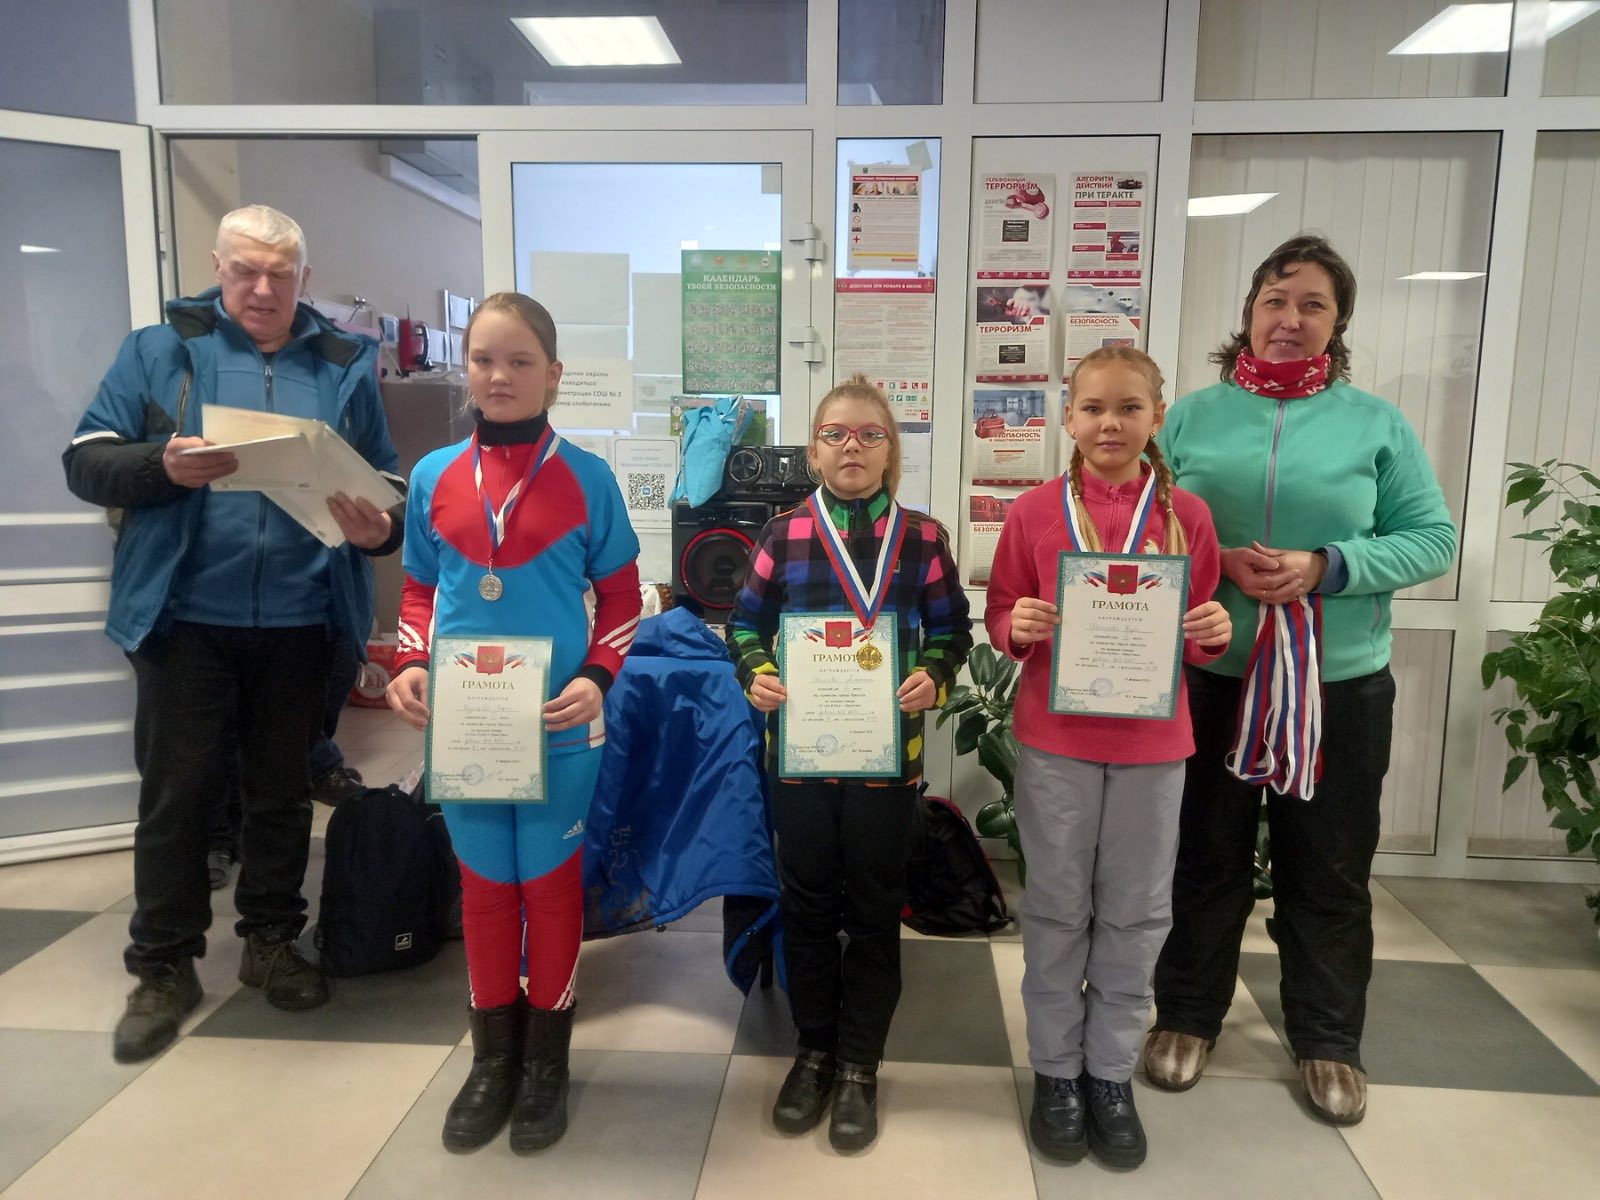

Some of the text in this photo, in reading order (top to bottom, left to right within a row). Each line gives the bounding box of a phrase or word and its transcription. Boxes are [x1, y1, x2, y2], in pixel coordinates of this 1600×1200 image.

[985, 182, 1038, 190] ТЕРРОРИЗМ
[1075, 191, 1134, 199] ПРИ ТЕРАКТЕ
[703, 274, 760, 283] КАЛЕНДАРЬ
[1092, 600, 1150, 612] ГРАМОТА
[813, 653, 857, 663] ГРАМОТ
[462, 680, 515, 690] ГРАМОТА
